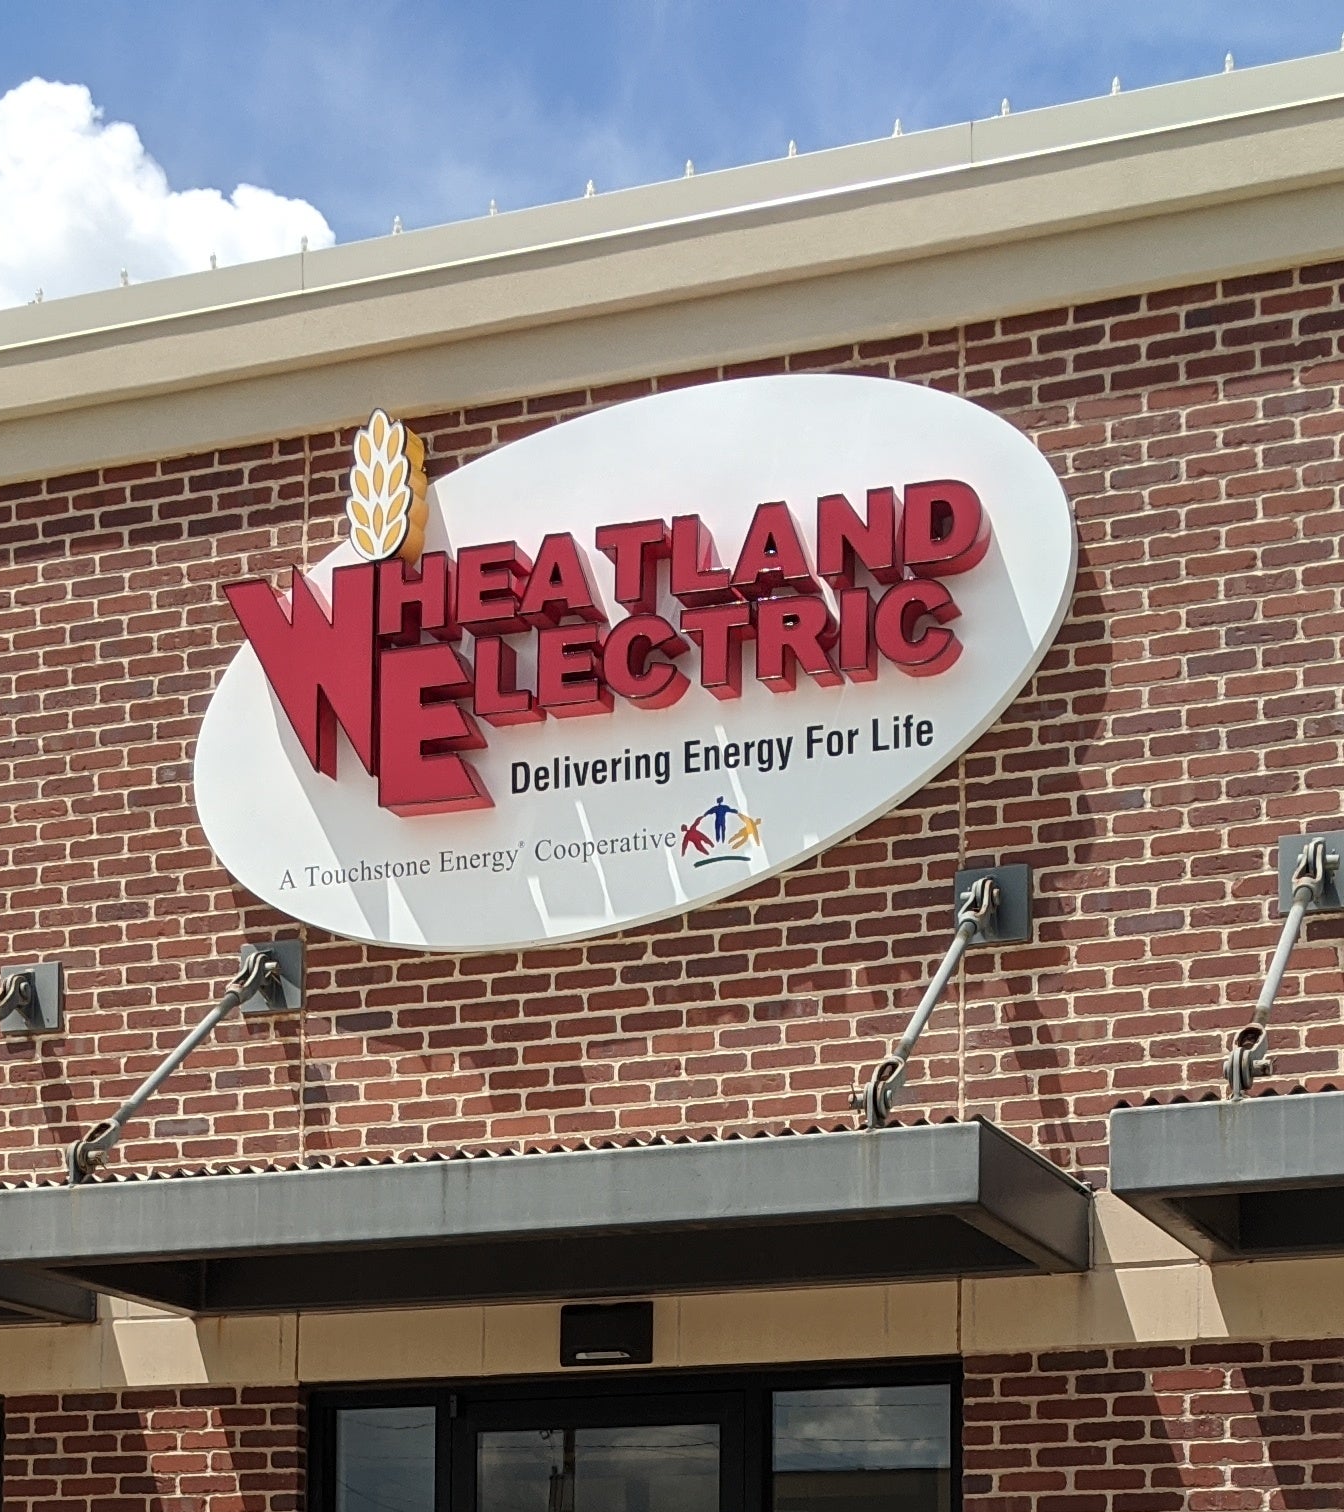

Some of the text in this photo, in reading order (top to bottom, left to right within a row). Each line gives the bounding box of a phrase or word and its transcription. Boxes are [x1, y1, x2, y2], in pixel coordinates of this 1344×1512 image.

[222, 479, 988, 781] WHEATLAND
[378, 577, 960, 812] ELECTRIC
[511, 713, 935, 795] Delivering Energy For Life
[278, 870, 297, 891] A
[304, 857, 432, 889] Touchstone
[534, 827, 678, 867] Cooperative
